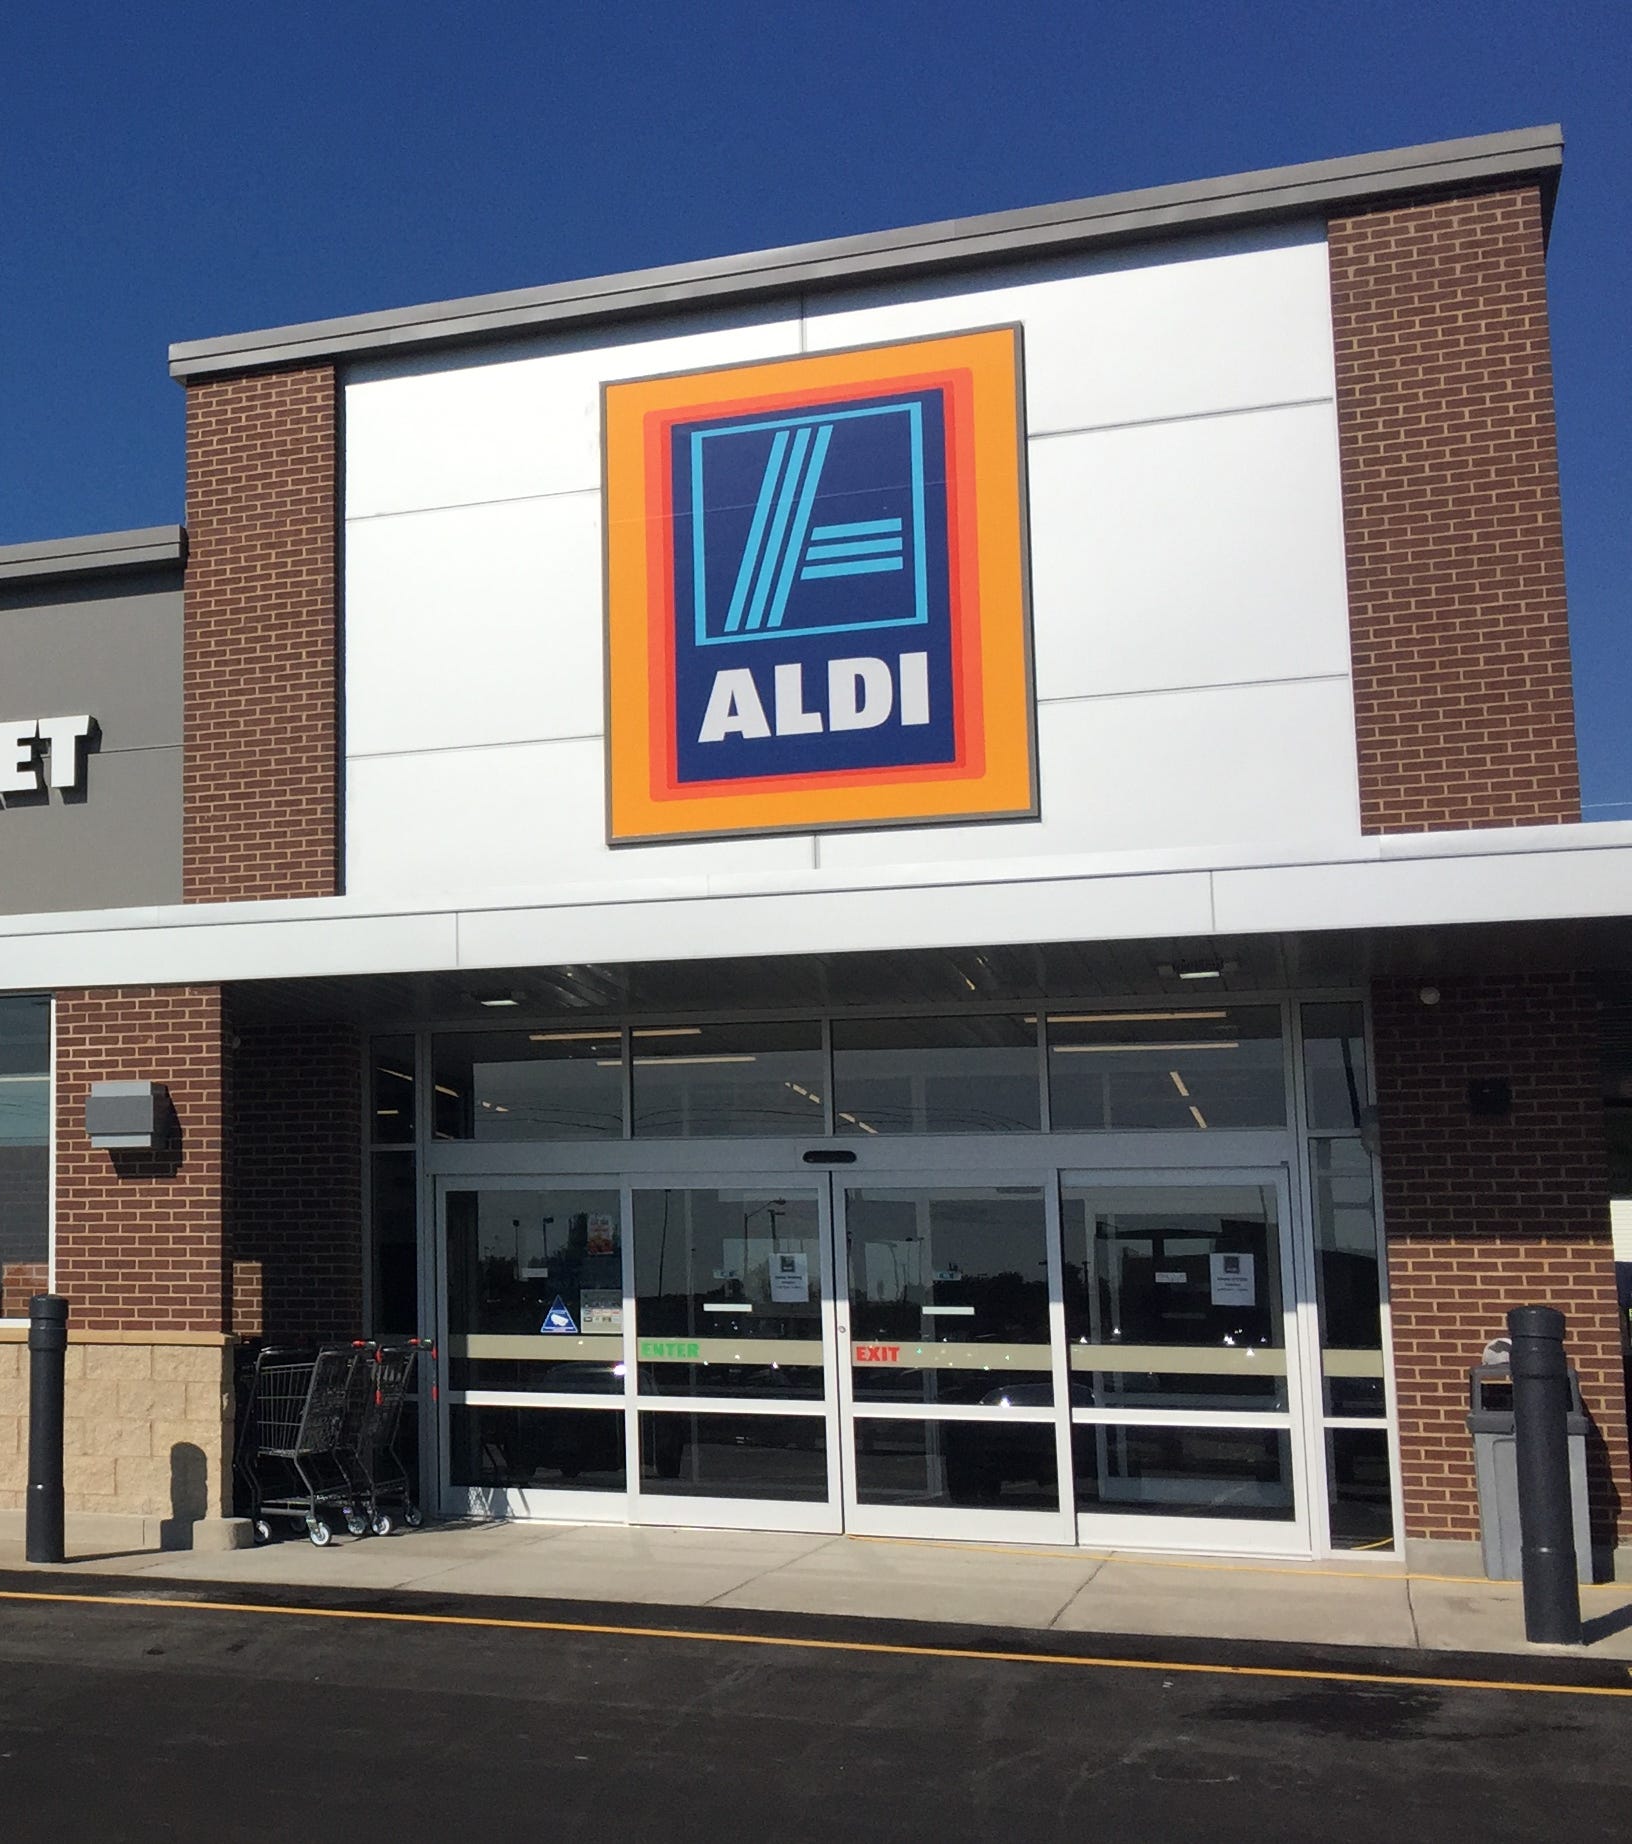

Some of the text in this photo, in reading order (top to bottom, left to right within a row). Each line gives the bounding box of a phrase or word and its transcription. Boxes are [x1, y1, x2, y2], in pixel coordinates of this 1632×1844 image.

[698, 652, 930, 743] ALDI
[641, 1342, 700, 1358] ENTER
[856, 1346, 900, 1362] EXIT
